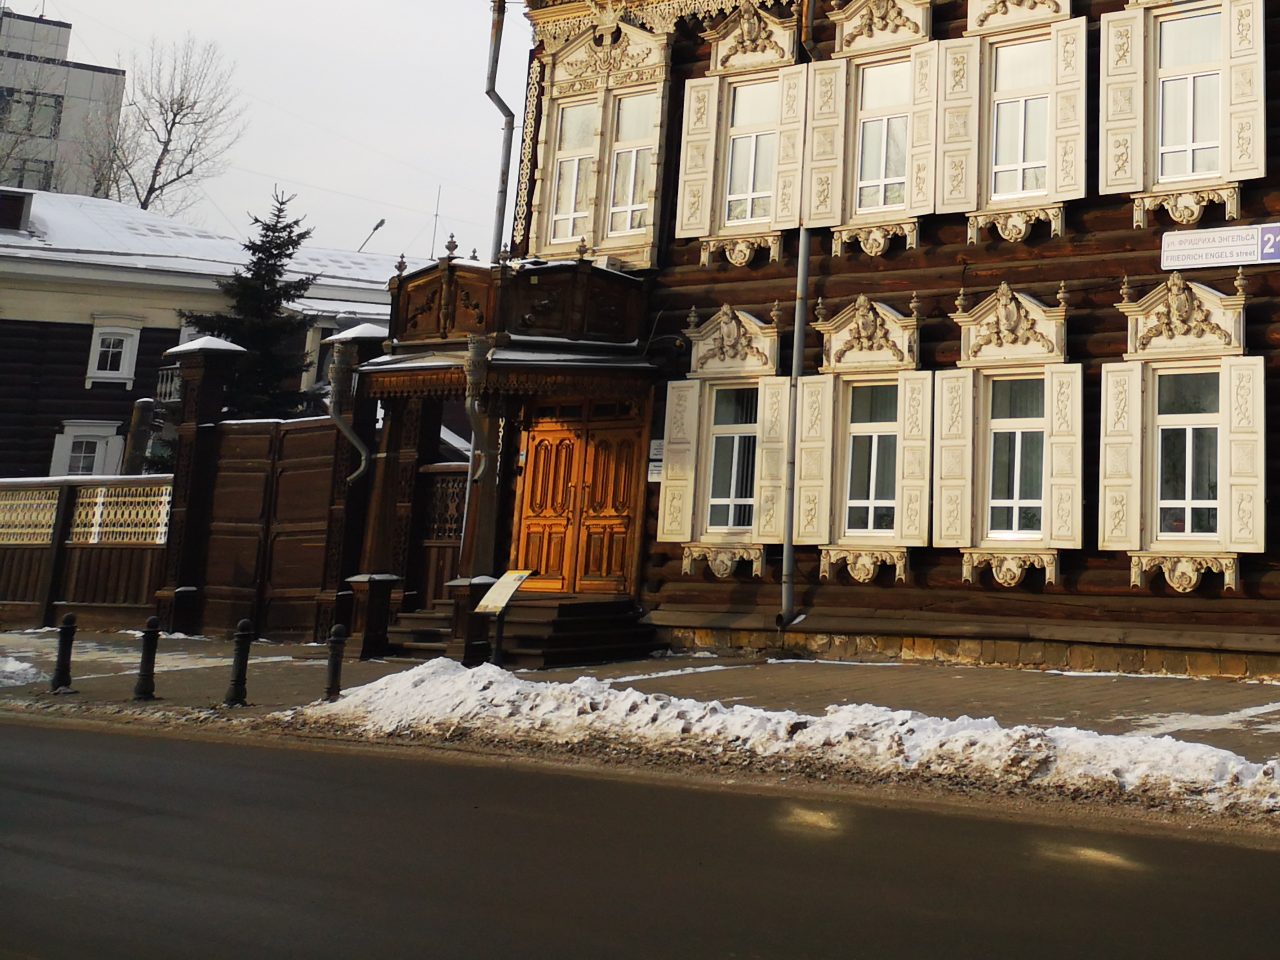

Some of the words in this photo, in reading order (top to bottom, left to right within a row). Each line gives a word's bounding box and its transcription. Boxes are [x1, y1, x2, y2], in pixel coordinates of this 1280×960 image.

[1178, 236, 1216, 246] ФРИДРИХА
[1218, 233, 1255, 244] ЭНГЕЛЬСА
[1166, 252, 1204, 262] FRIEDRICH
[1205, 250, 1234, 260] ENGELS
[1235, 249, 1256, 258] street
